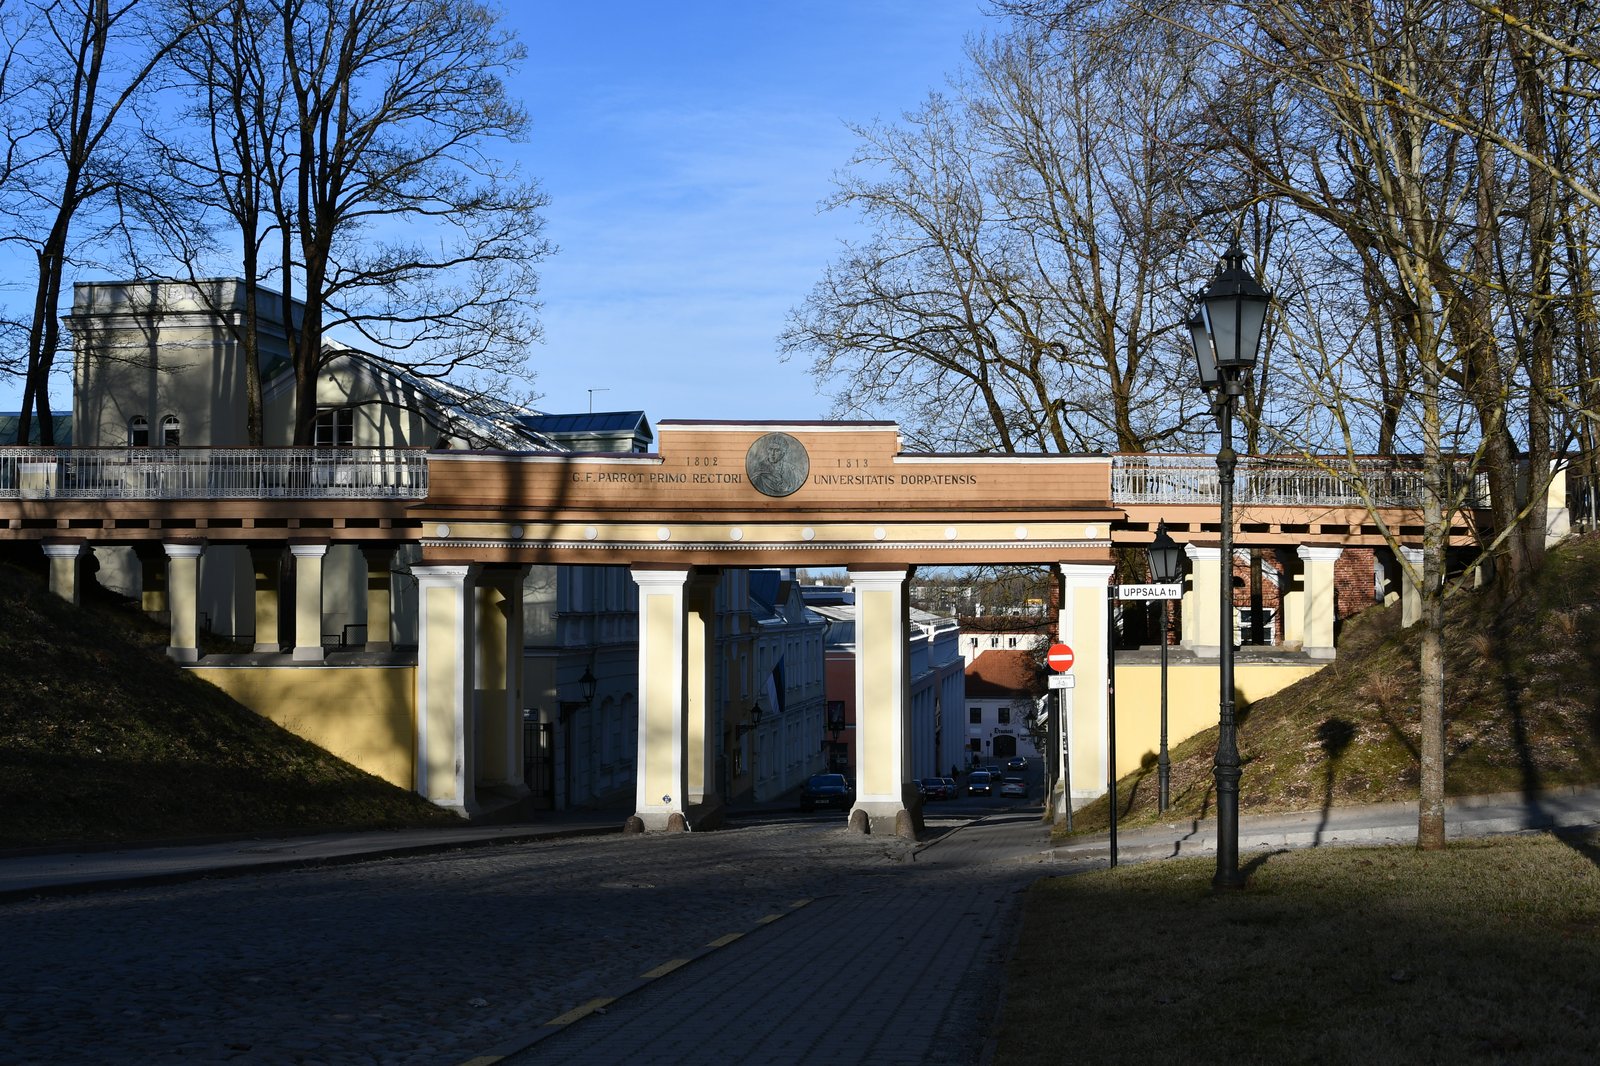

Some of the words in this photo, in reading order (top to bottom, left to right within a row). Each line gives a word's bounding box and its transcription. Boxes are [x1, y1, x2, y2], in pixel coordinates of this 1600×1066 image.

[686, 456, 719, 467] 1802
[837, 458, 869, 468] 1813
[650, 473, 687, 484] PRIMO
[692, 473, 742, 484] RECTORI
[814, 474, 895, 485] UNIVERSITATIS
[901, 474, 977, 485] DORPATENSIS
[1123, 587, 1167, 597] UPPSALA
[1168, 588, 1177, 597] tn
